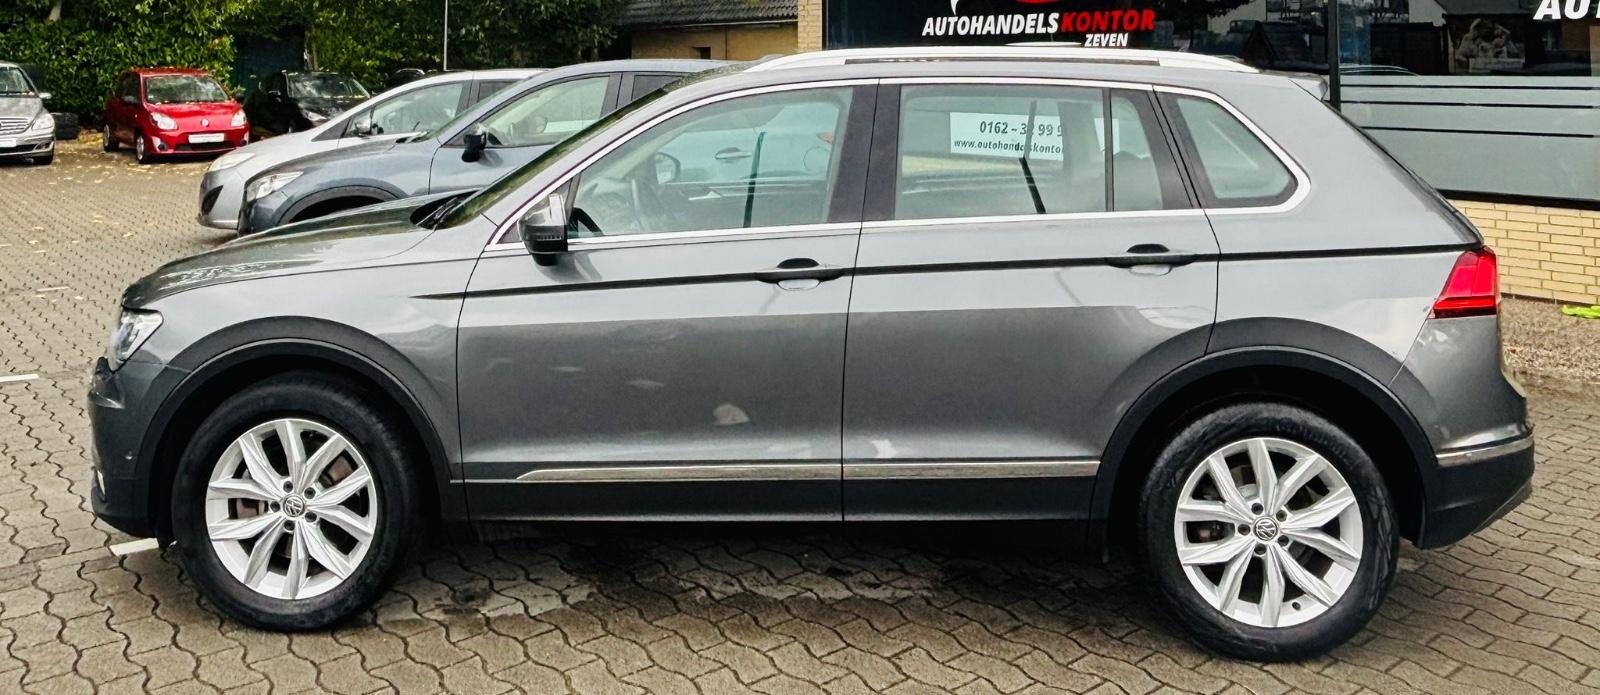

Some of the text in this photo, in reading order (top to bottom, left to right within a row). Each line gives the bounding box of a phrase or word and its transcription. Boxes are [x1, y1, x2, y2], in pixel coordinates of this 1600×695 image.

[1533, 0, 1600, 20] AU
[1084, 32, 1129, 48] ZEVEN
[979, 120, 1008, 135] 0162
[1038, 123, 1054, 137] 99
